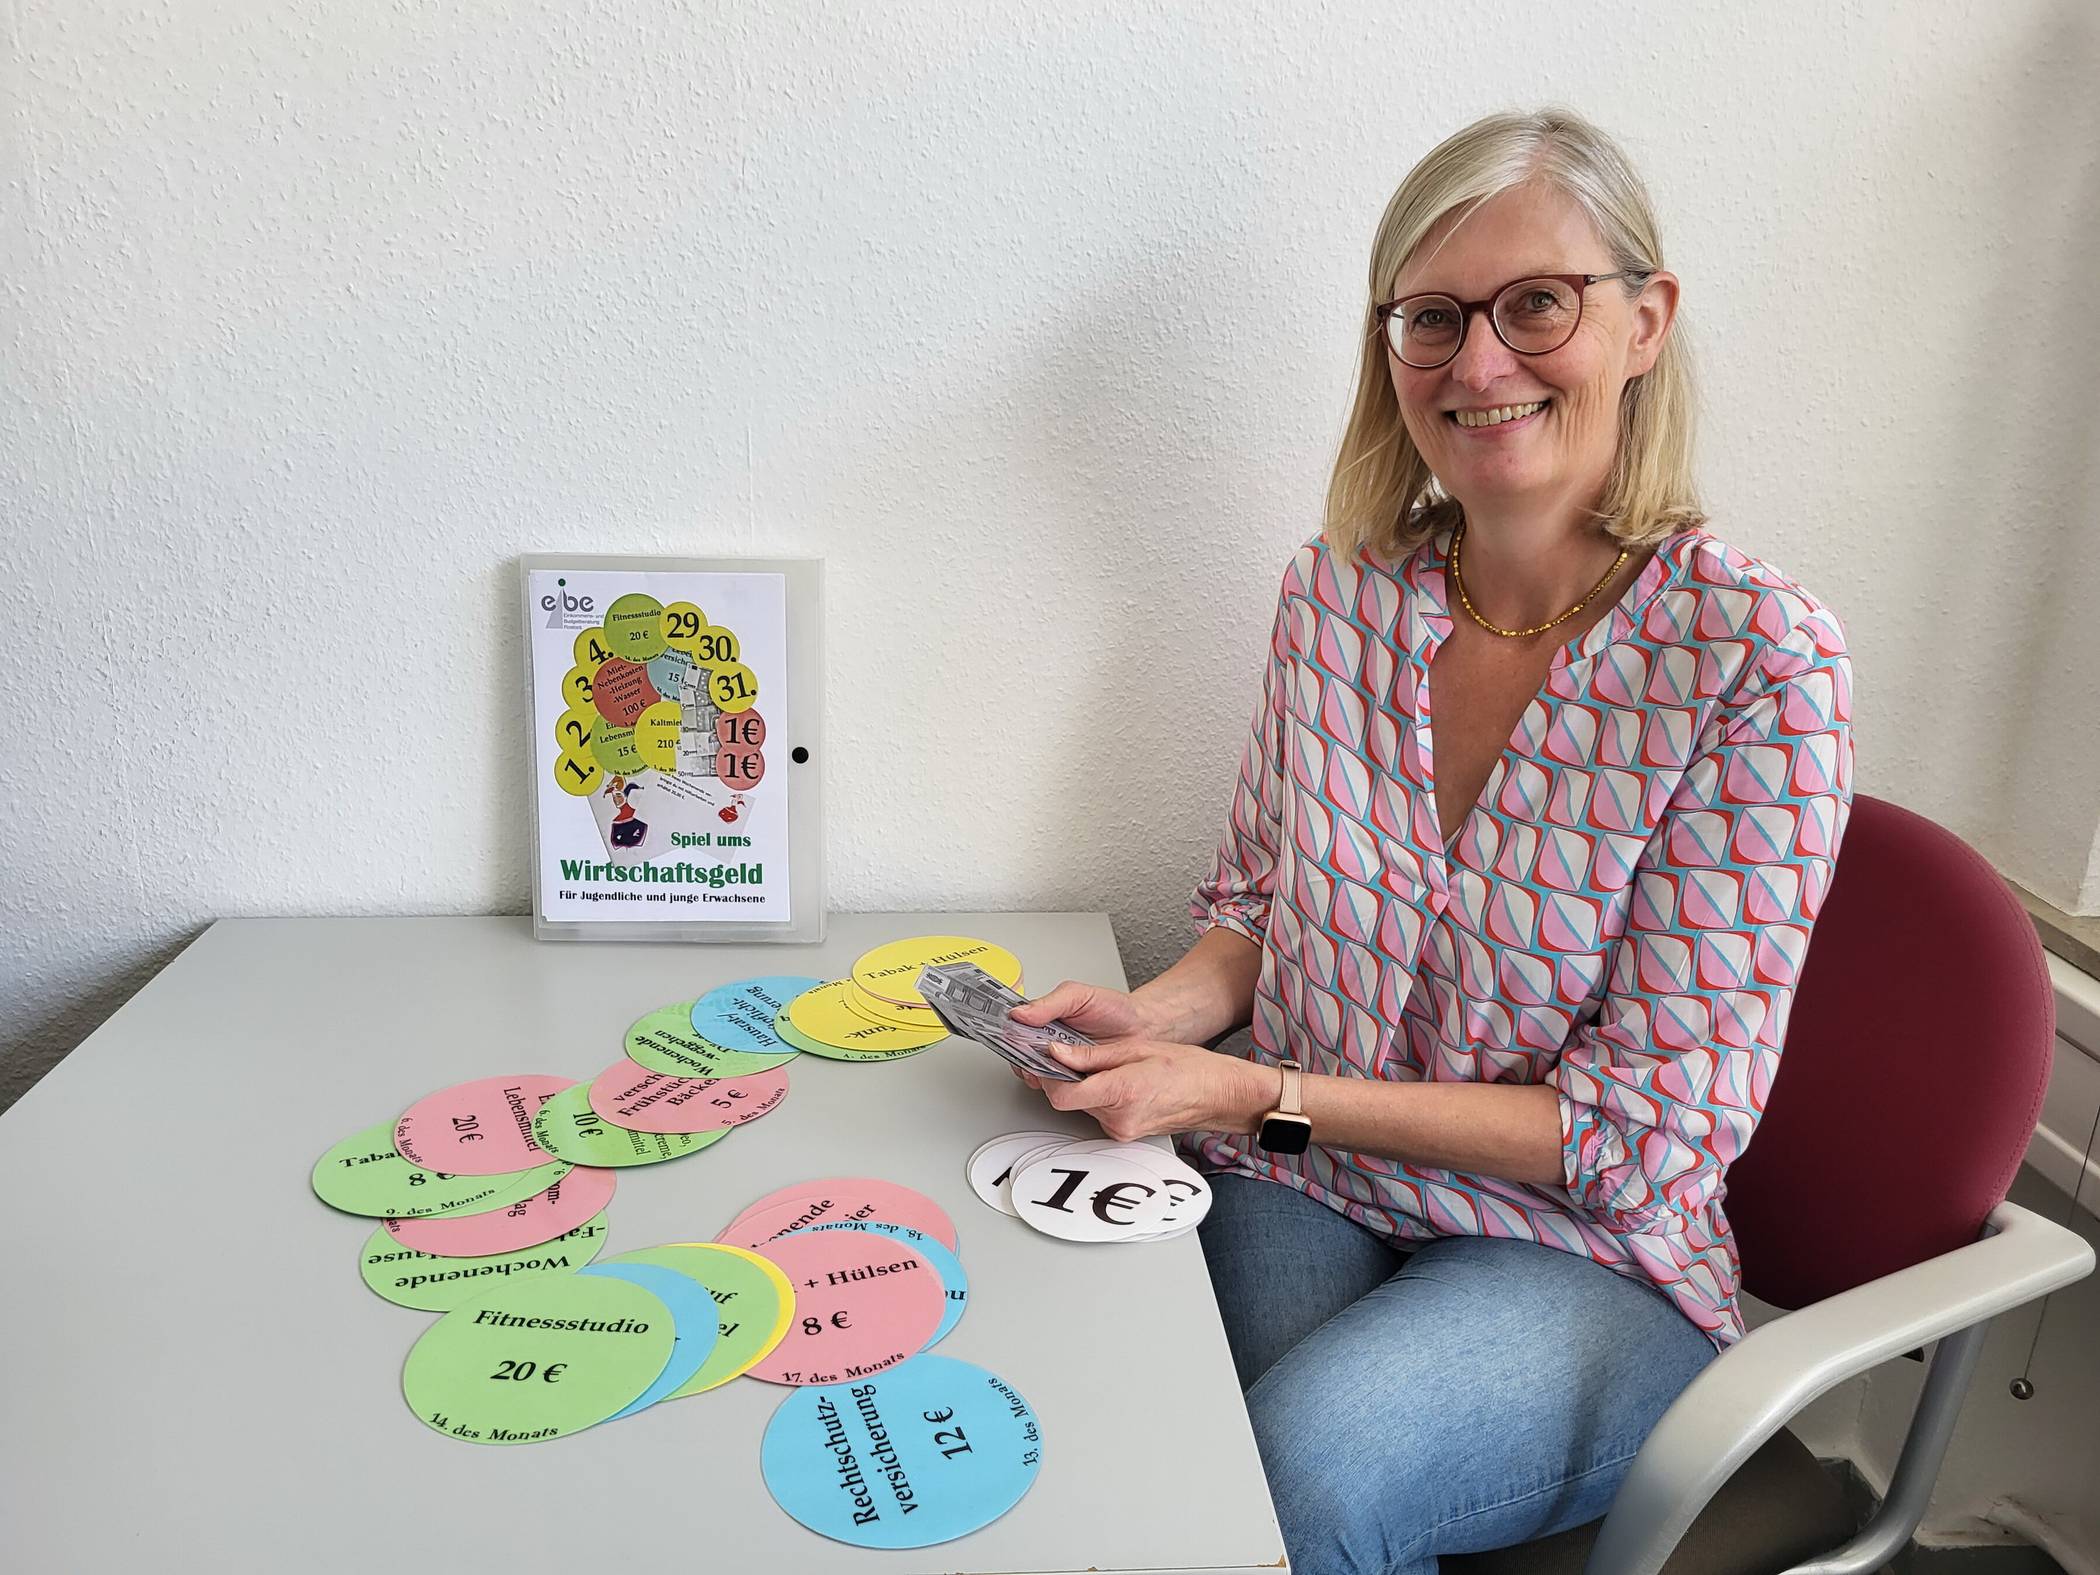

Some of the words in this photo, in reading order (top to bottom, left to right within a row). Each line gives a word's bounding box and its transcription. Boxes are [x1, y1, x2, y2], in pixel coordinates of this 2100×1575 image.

[612, 609, 662, 622] Fitnessstudio
[666, 612, 699, 638] 29
[629, 631, 641, 641] 20
[643, 630, 649, 640] €
[588, 638, 614, 665] 4.
[699, 635, 737, 662] 30.
[597, 665, 644, 689] Nebenkosten
[608, 677, 643, 694] -Heizung
[668, 671, 680, 683] 15
[716, 671, 757, 703] 31.
[613, 687, 641, 704] -Wasser
[622, 702, 640, 717] 100
[617, 744, 629, 757] 15
[656, 739, 674, 749] 210
[564, 758, 595, 785] 1.
[671, 831, 711, 848] Spiel
[717, 835, 751, 847] ums
[560, 858, 763, 888] Wirtschaftsgeld
[559, 889, 578, 900] Für
[579, 890, 643, 902] Jugendliche
[646, 892, 666, 902] und
[669, 893, 699, 904] junge
[702, 891, 766, 904] Erwachsene
[863, 961, 918, 979] Tabak
[930, 945, 989, 964] Hülsen
[634, 1034, 715, 1077] Wochenende
[654, 1029, 721, 1062] -weggehen
[613, 1072, 665, 1103] versch
[616, 1077, 692, 1118] Frühstüc
[710, 1097, 733, 1110] 5
[728, 1088, 749, 1101] €
[739, 1109, 759, 1121] des
[755, 1087, 786, 1112] Monats
[452, 1115, 479, 1132] 20
[572, 1110, 597, 1127] 10
[459, 1133, 484, 1144] €
[537, 1130, 559, 1154] Monats
[577, 1127, 603, 1139] €
[339, 1149, 402, 1168] Taba
[399, 1138, 423, 1164] Monats
[408, 1172, 427, 1187] 8
[385, 1208, 401, 1216] 9.
[406, 1206, 433, 1216] des
[440, 1188, 496, 1211] Monats
[1030, 1168, 1157, 1226] 1€
[811, 1221, 869, 1233] Monats
[875, 1222, 900, 1235] des
[904, 1227, 924, 1241] 18.
[394, 1254, 571, 1289] Wochenende
[803, 1276, 820, 1290] +
[825, 1257, 921, 1287] Hülsen
[471, 1309, 650, 1335] Fitnessstudio
[802, 1315, 823, 1336] 8
[830, 1309, 853, 1331] €
[489, 1359, 537, 1382] 20
[541, 1360, 569, 1384] €
[781, 1370, 804, 1384] 17.
[809, 1371, 839, 1385] des
[844, 1350, 906, 1379] Monats
[987, 1376, 1031, 1419] Monats
[428, 1411, 449, 1429] 14.
[451, 1424, 482, 1441] des
[486, 1424, 560, 1443] Monats
[922, 1405, 955, 1425] €
[933, 1425, 974, 1461] 12
[1023, 1420, 1040, 1443] des
[815, 1395, 882, 1528] Rechtschutz-
[850, 1383, 920, 1516] versicherung
[1021, 1446, 1040, 1468] 13.
